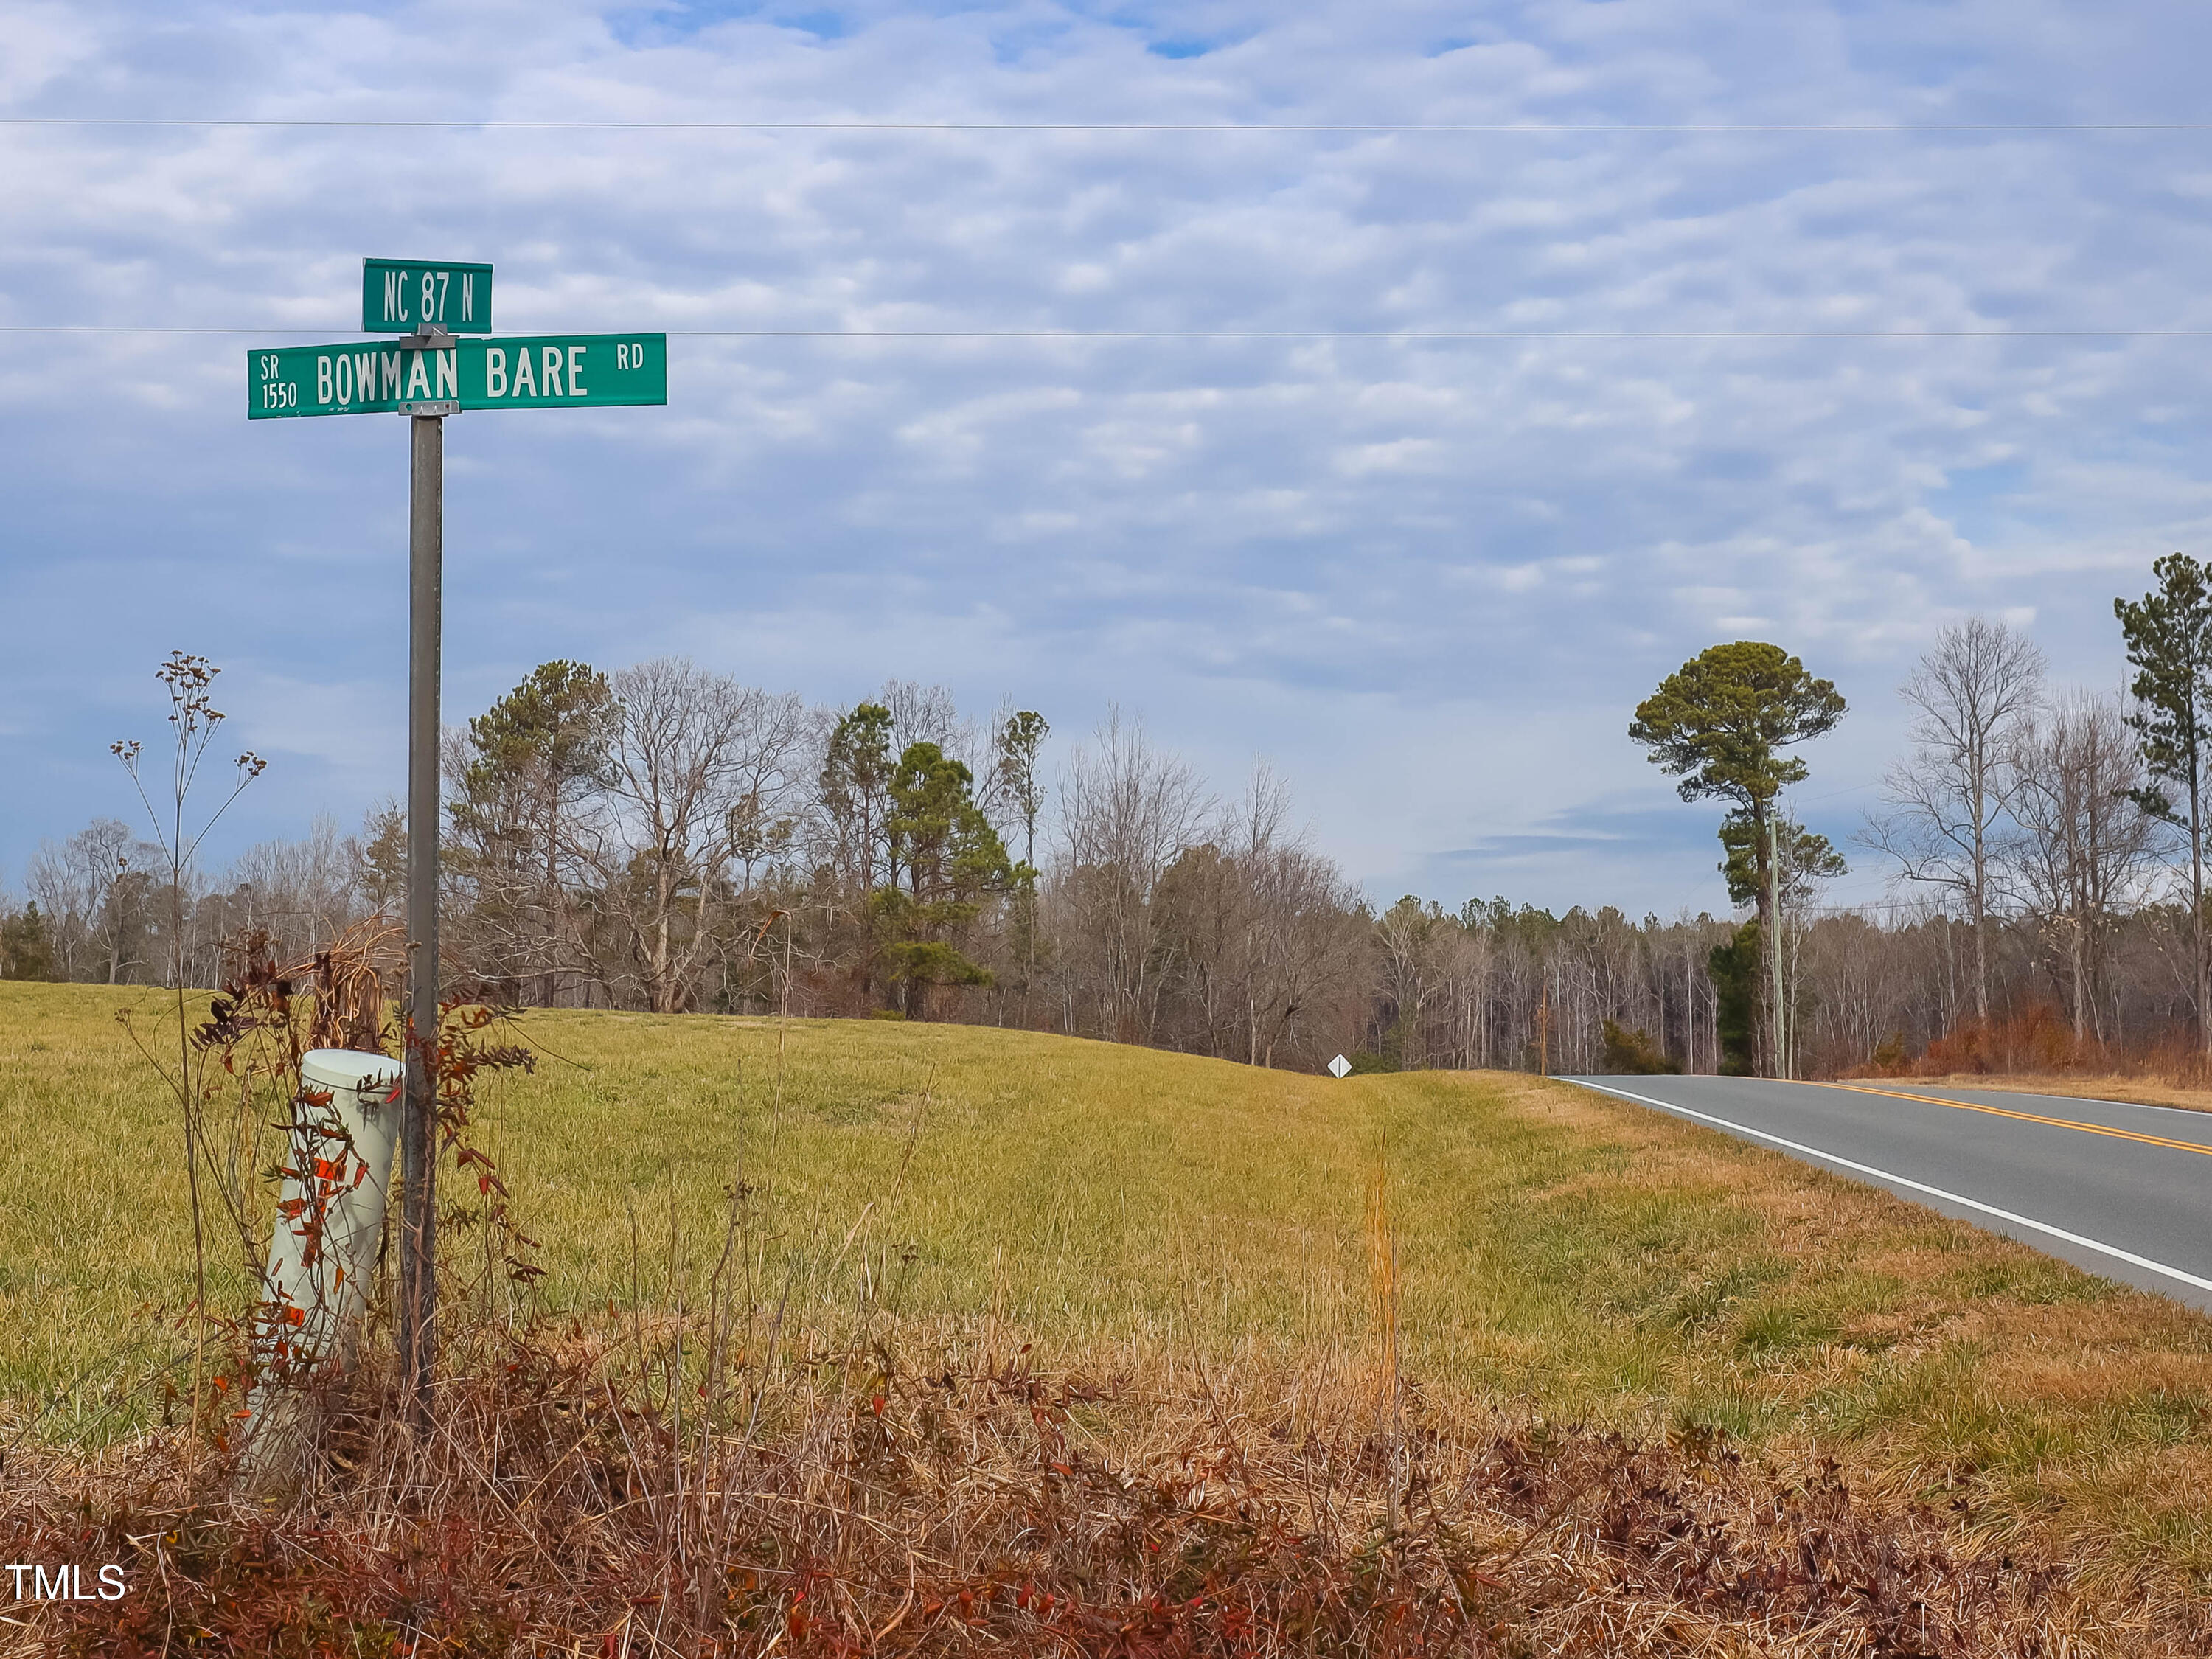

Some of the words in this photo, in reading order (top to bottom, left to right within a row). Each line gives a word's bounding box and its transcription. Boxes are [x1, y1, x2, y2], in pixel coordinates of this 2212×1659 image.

[383, 271, 408, 322] NC
[421, 272, 449, 322] 87
[462, 273, 473, 321] N
[260, 355, 279, 380] SR
[317, 349, 458, 406] BOWMAN
[487, 346, 588, 397] BARE
[616, 344, 644, 370] RD
[262, 382, 297, 408] 1550
